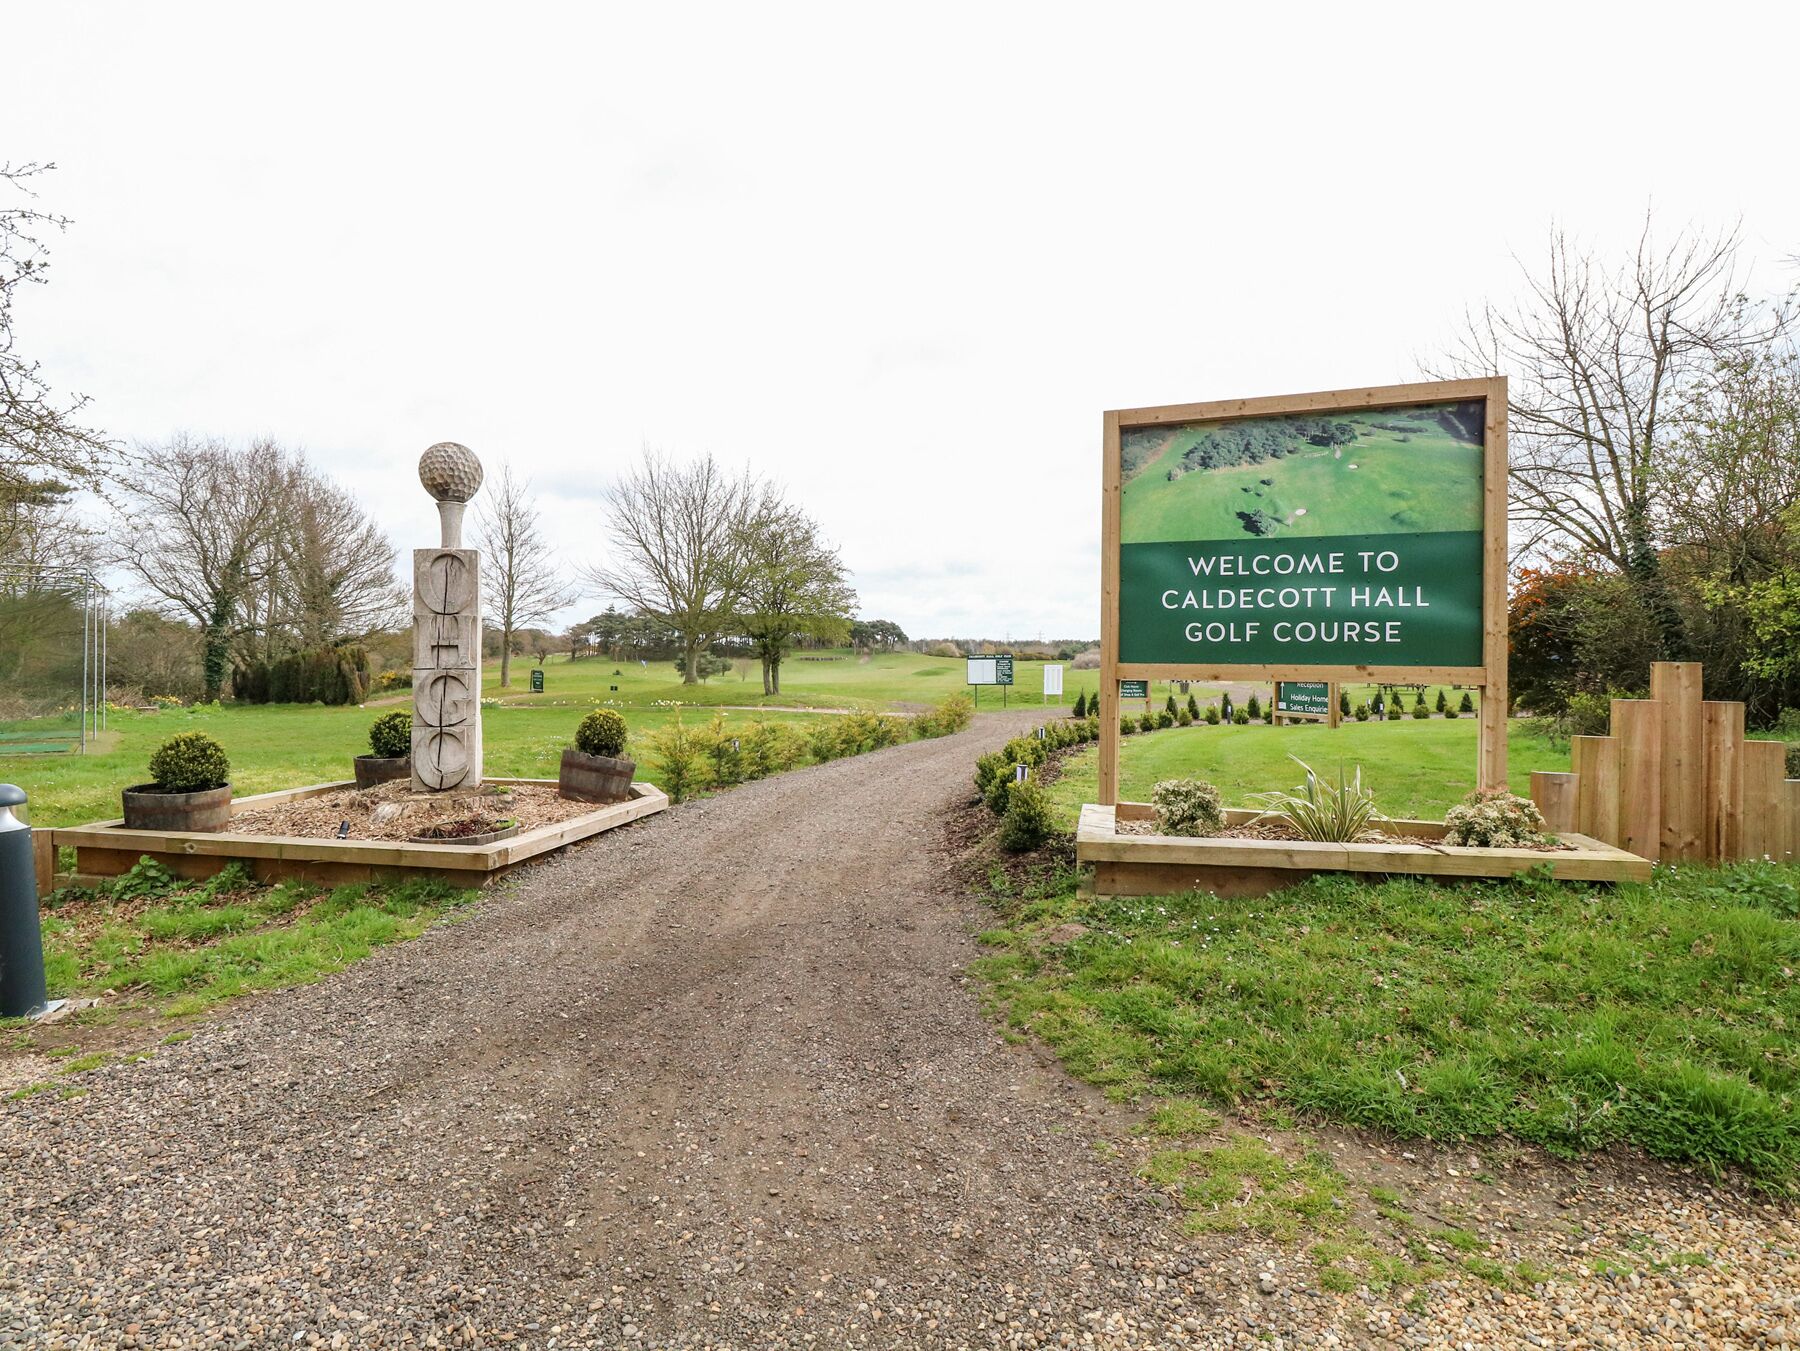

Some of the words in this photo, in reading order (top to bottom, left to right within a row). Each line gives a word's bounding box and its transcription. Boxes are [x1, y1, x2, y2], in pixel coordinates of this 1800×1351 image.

[1188, 552, 1344, 576] WELCOME
[1358, 551, 1399, 572] TO
[1161, 587, 1337, 609] CALDECOTT
[1351, 586, 1430, 607] HALL
[1185, 622, 1261, 642] GOLF
[1273, 621, 1401, 642] COURSE
[1290, 694, 1311, 703] Holiday
[1312, 695, 1328, 703] Home
[1304, 705, 1328, 714] Enquirie
